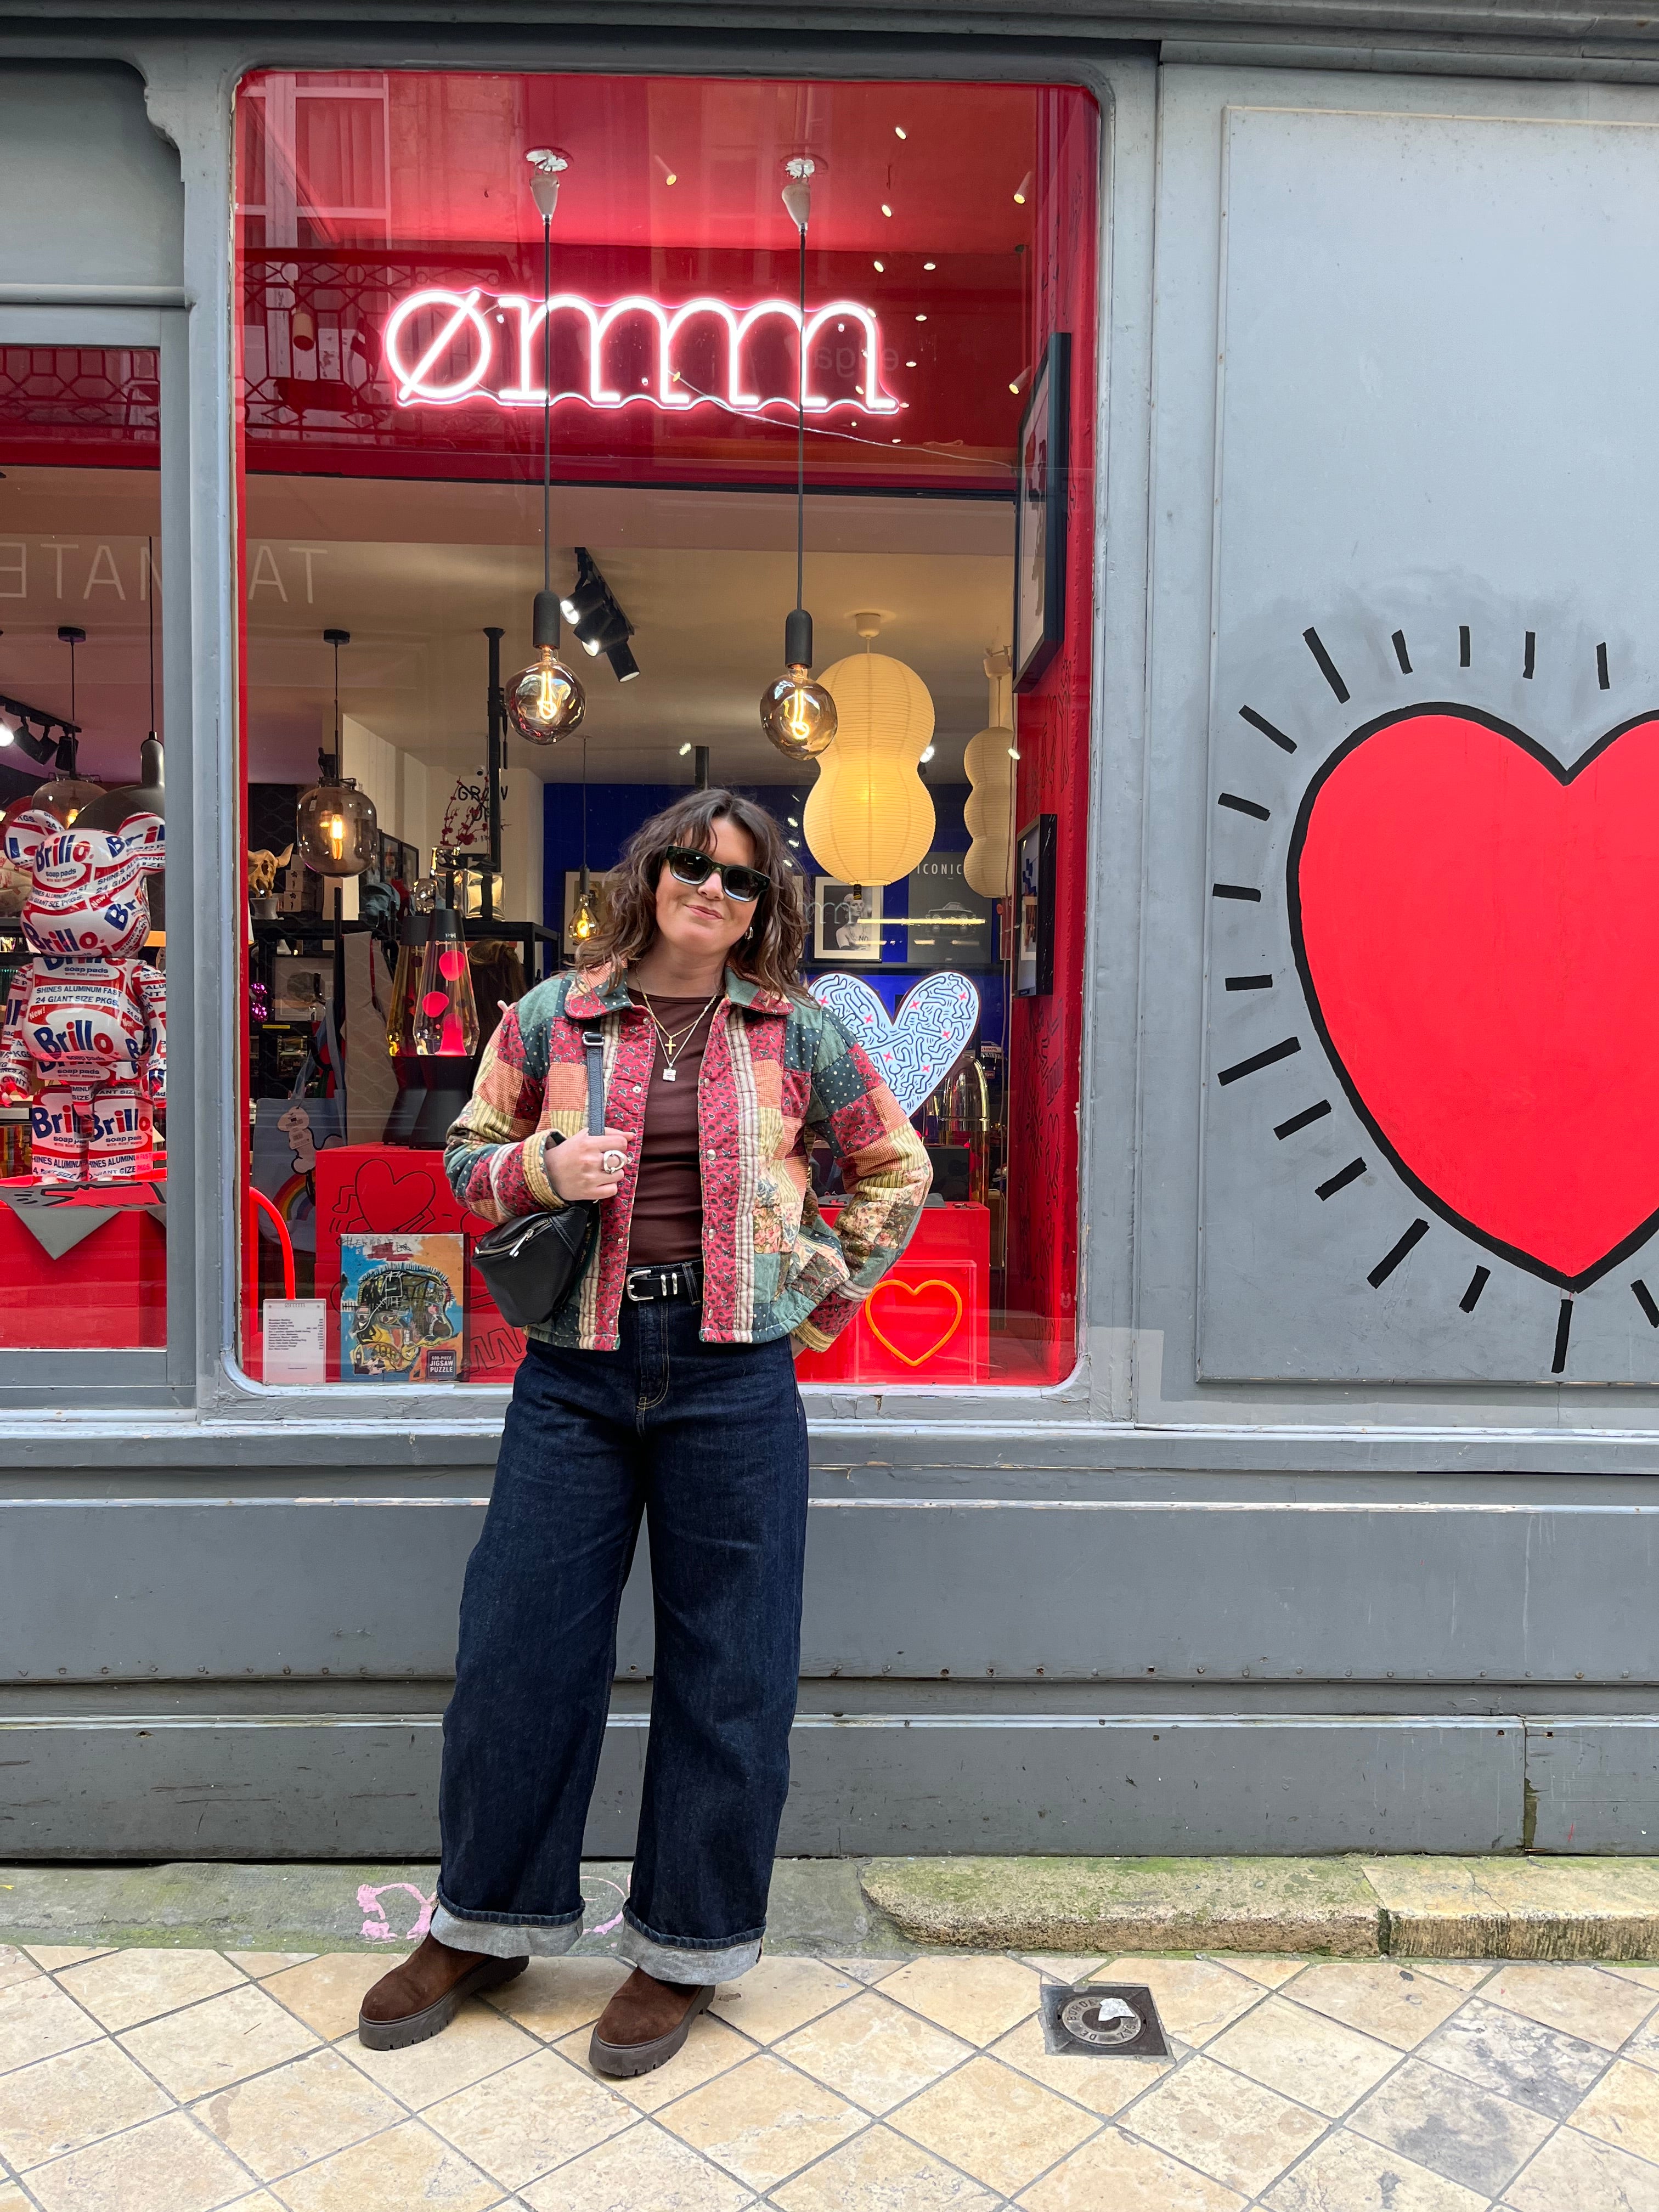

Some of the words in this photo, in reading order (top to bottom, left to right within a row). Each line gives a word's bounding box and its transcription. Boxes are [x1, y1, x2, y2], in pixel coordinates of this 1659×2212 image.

[917, 863, 962, 874] ICONIC
[103, 988, 122, 997] FAST
[29, 1006, 46, 1019] New!
[33, 1020, 114, 1059] Brillo
